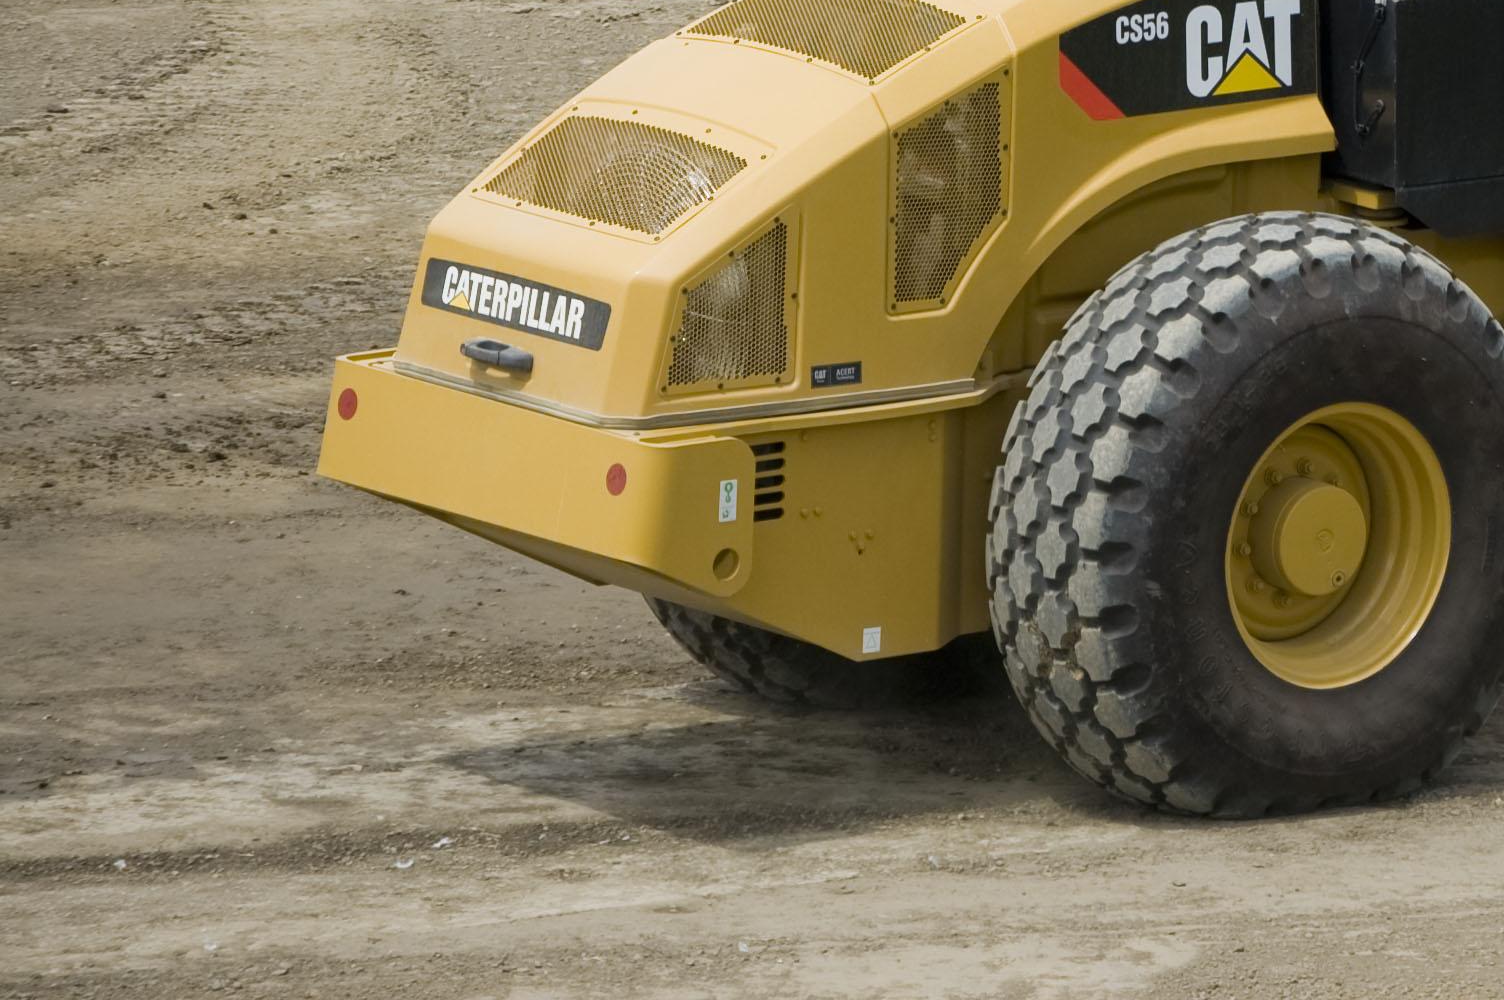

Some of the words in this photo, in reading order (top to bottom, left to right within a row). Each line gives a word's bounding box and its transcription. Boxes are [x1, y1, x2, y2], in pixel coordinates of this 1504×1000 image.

[1115, 11, 1169, 45] CS56
[441, 265, 586, 340] CATERPILLAR
[814, 369, 827, 380] CAT
